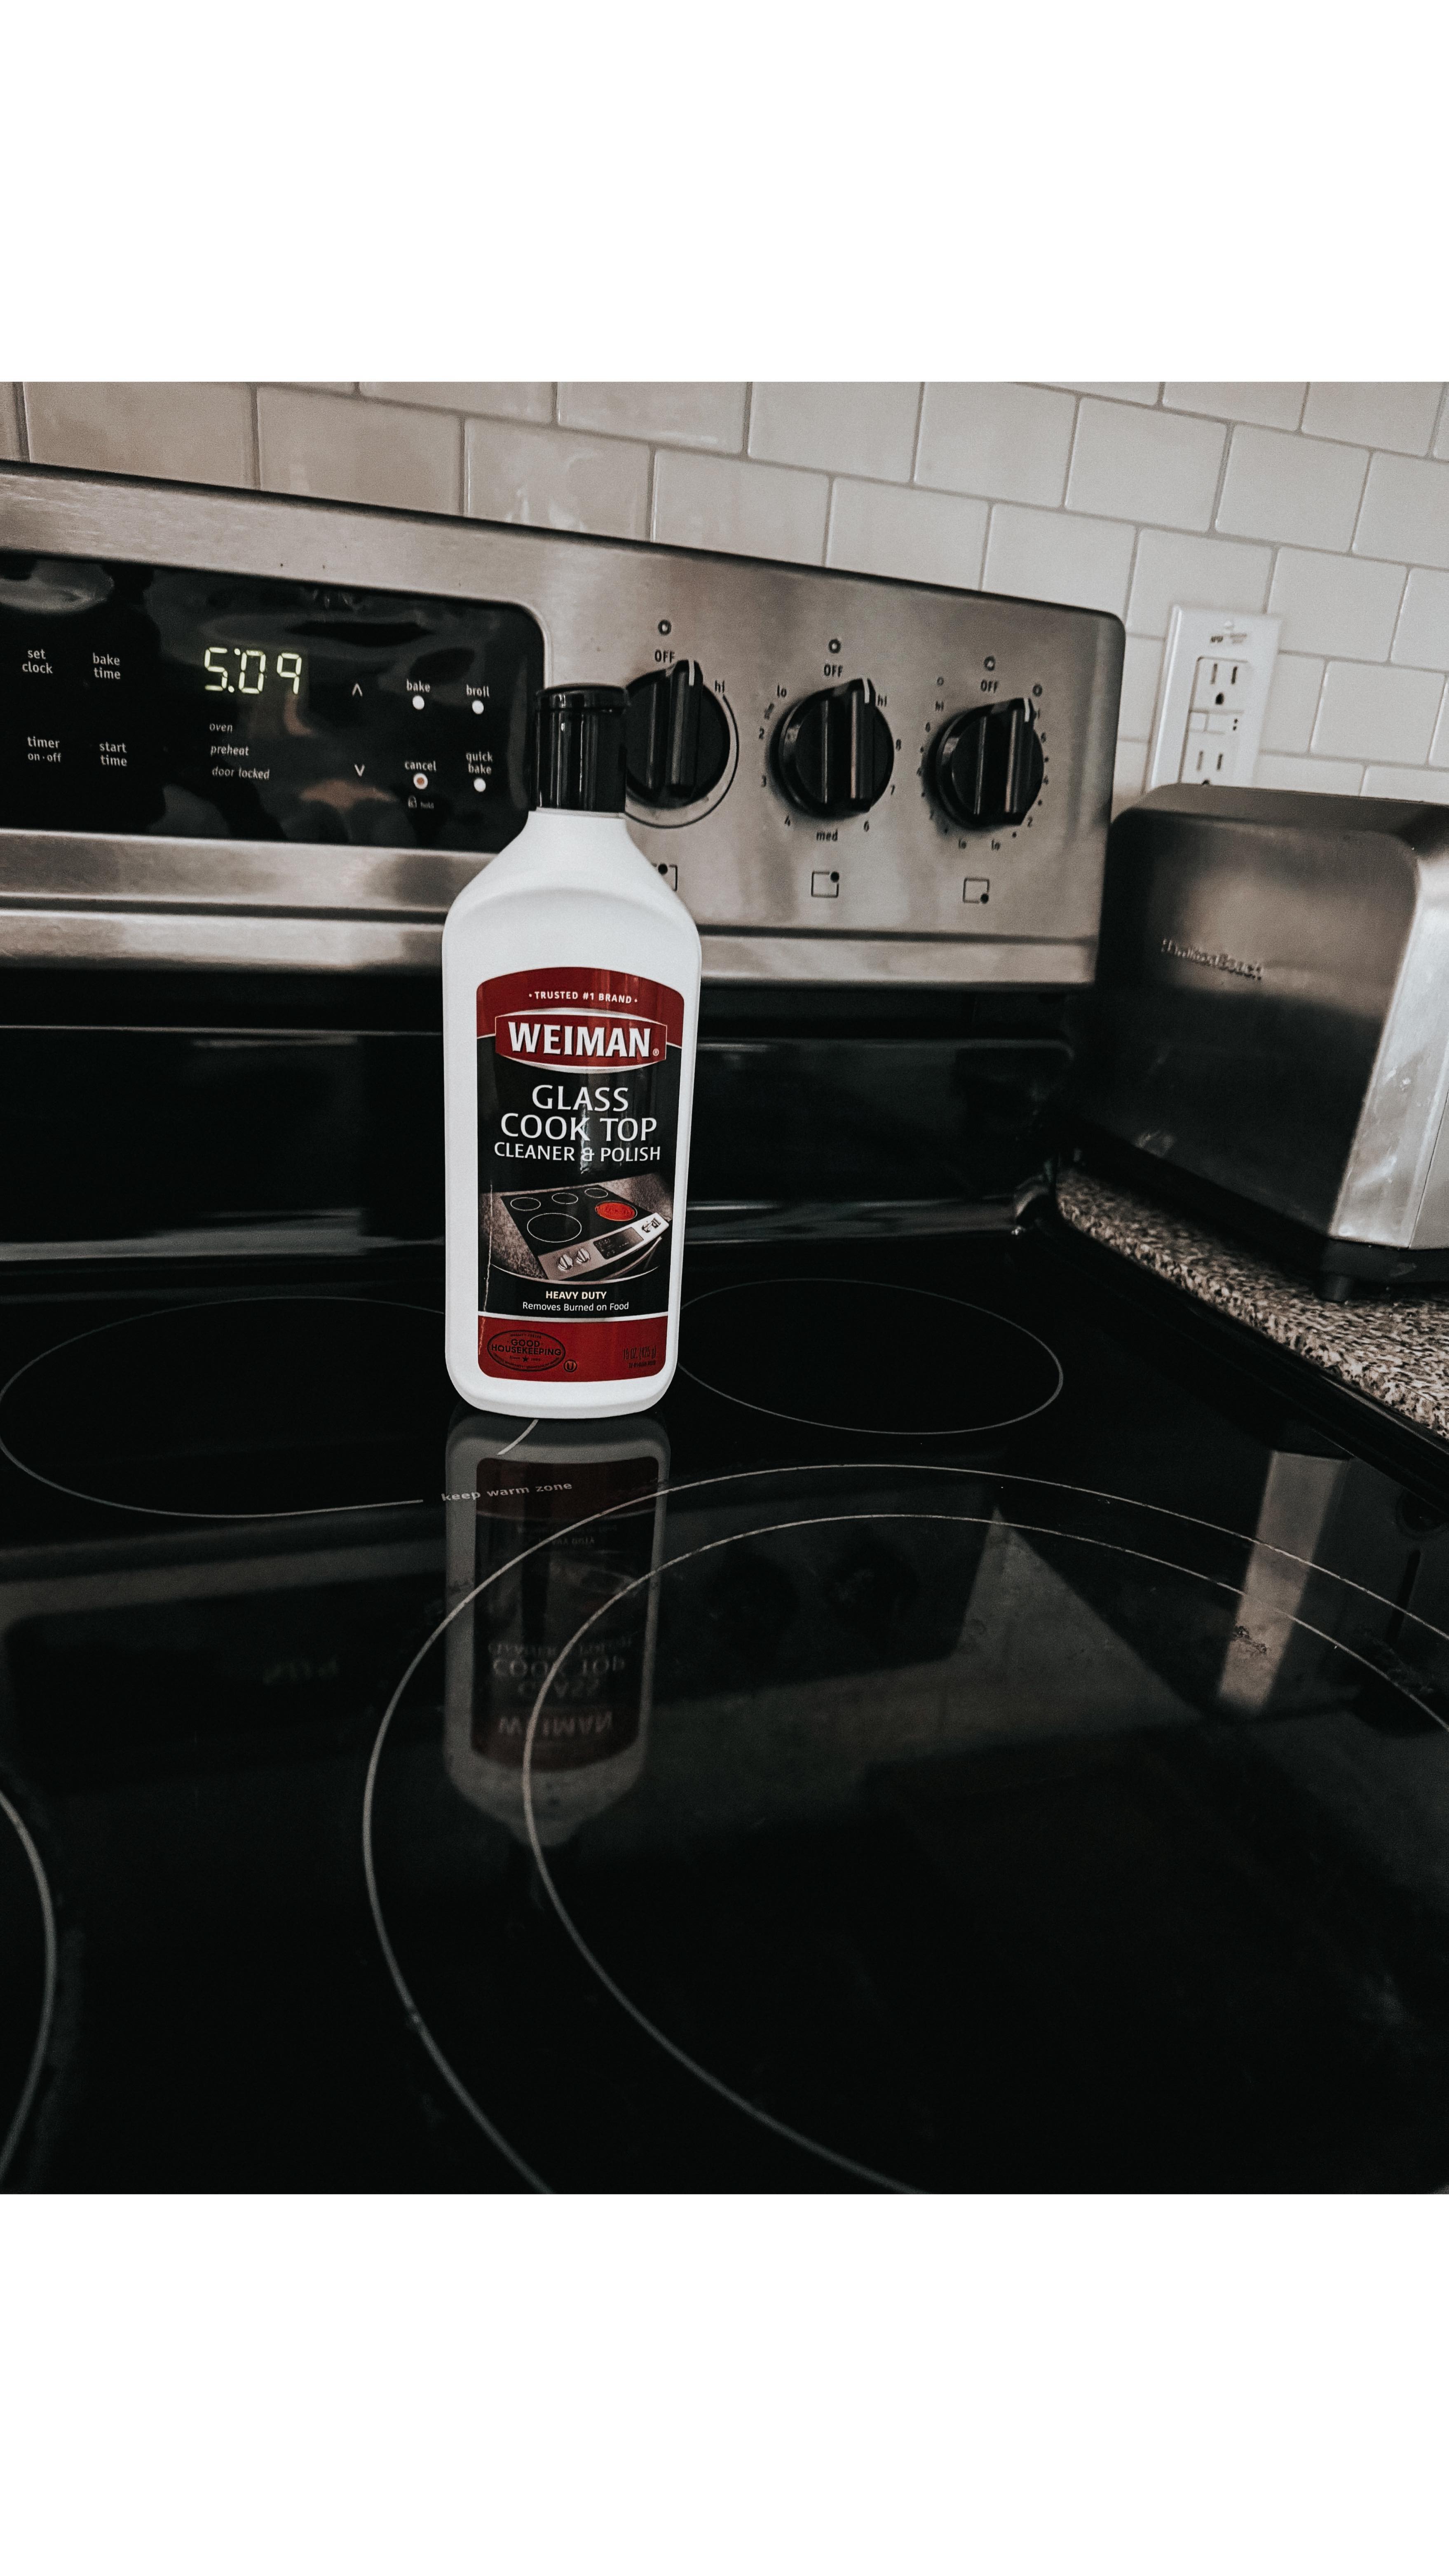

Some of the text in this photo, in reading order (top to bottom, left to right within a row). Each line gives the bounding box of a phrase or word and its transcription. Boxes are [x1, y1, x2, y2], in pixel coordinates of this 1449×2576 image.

[27, 649, 46, 659] set
[93, 652, 120, 666] bake
[654, 649, 675, 663] OFF
[22, 661, 53, 674] clock
[94, 666, 121, 680] time
[204, 647, 302, 695] 5:09
[823, 664, 843, 678] OFF
[406, 678, 431, 692] bake
[466, 684, 490, 697] broil
[714, 679, 725, 693] hi
[776, 684, 787, 698] lo
[980, 679, 999, 693] OFF
[209, 723, 233, 733] oven
[27, 736, 60, 748] timer
[99, 741, 127, 753] start
[210, 744, 249, 756] preheat
[100, 754, 127, 767] time
[466, 751, 492, 763] quick
[404, 760, 436, 772] cancel
[468, 763, 492, 774] bake
[212, 766, 270, 780] door locked
[816, 829, 838, 842] med
[535, 991, 632, 1004] TRUSTED #1 BRAND
[532, 1084, 628, 1112] GLASS
[501, 1112, 657, 1142] COOK TOP
[494, 1142, 661, 1162] CLEANER & POLISH
[546, 1290, 607, 1300] HEAVY DUTY
[523, 1301, 561, 1311] Removes
[563, 1302, 594, 1311] Burned
[610, 1302, 629, 1311] Food
[511, 1338, 540, 1347] GOOD
[491, 1344, 561, 1356] HOUSEKEEPING
[441, 1483, 572, 1501] keep warm zone
